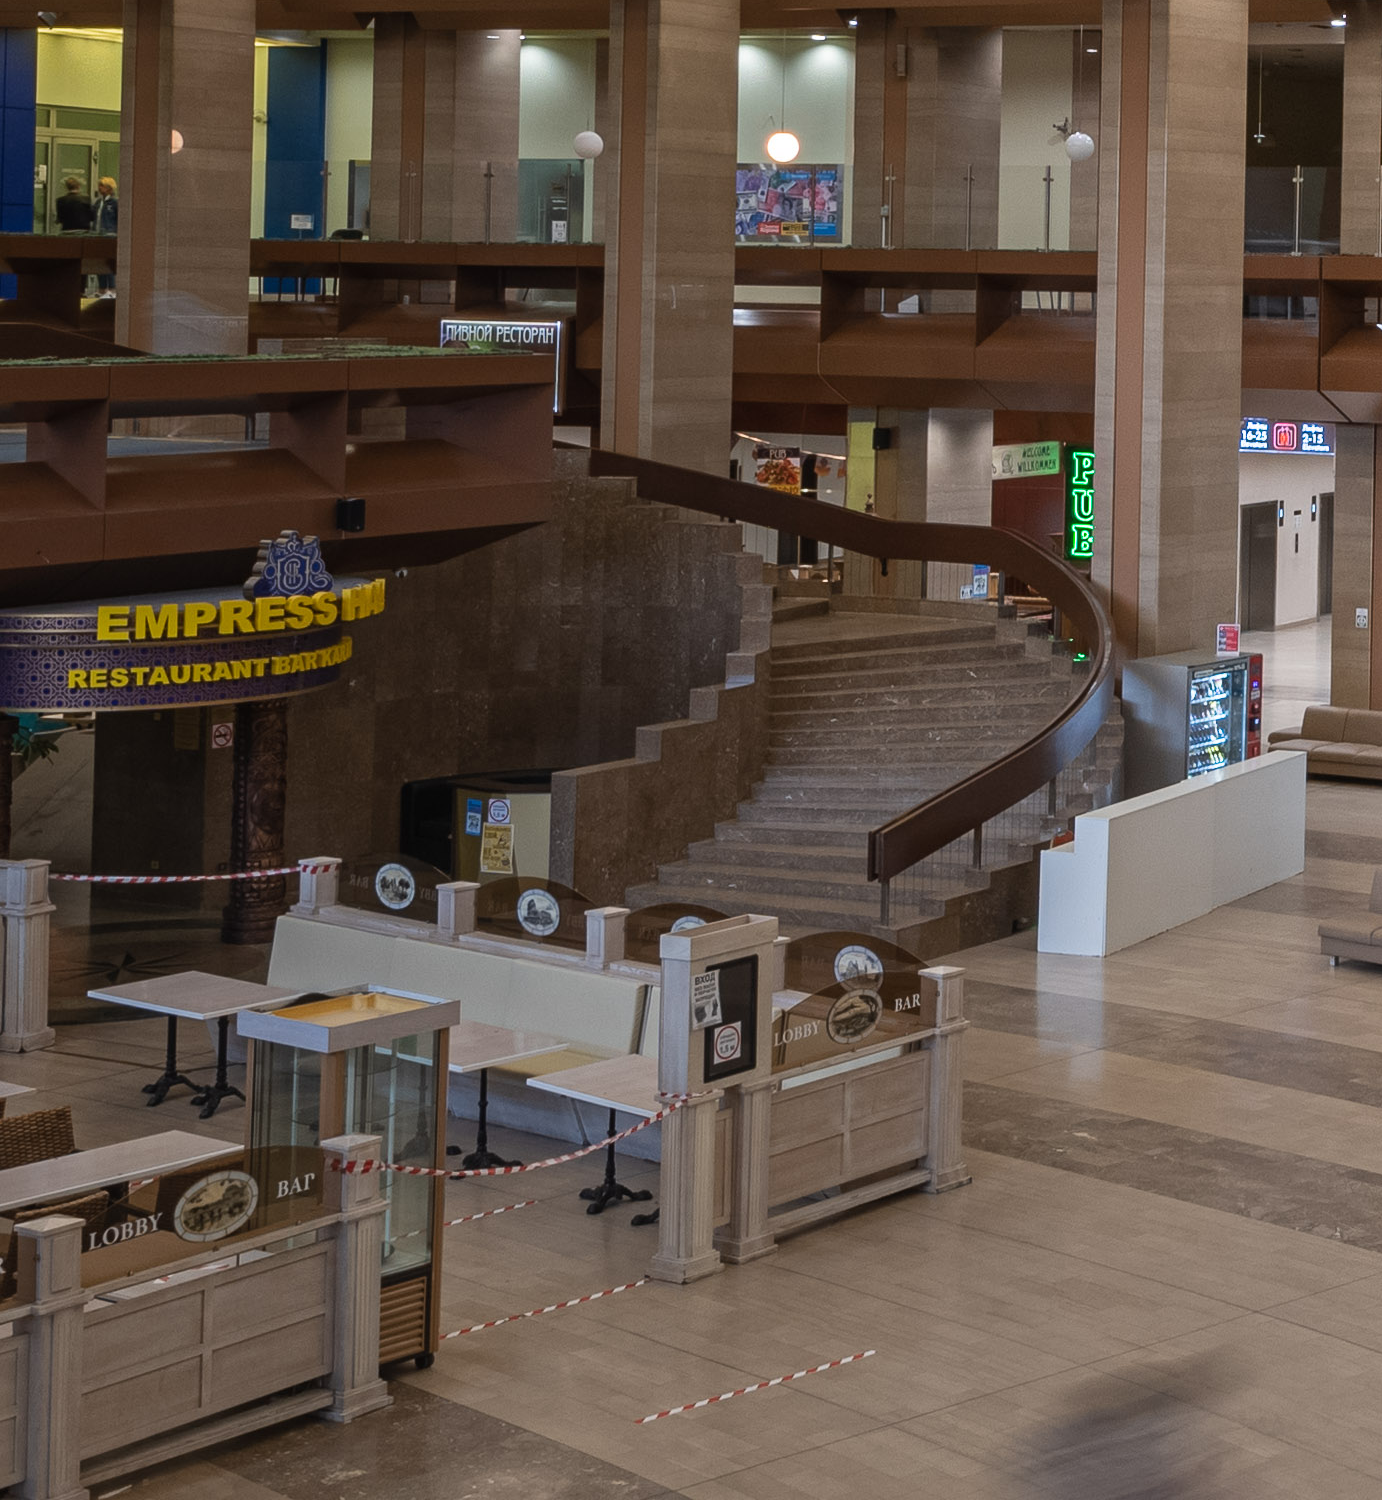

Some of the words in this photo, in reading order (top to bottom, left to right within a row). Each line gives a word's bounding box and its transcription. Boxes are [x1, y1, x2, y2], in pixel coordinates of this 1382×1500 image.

[446, 325, 492, 342] ПИВНОЙ
[496, 326, 554, 344] РЕСТОРАН
[1241, 430, 1268, 441] 16-25
[1302, 433, 1324, 444] 2-15
[769, 449, 787, 459] PUB
[1022, 445, 1051, 458] WELCOME
[1017, 459, 1057, 472] WILLKOMMEN
[1071, 452, 1095, 556] PUB
[97, 591, 338, 640] EMPRESS
[67, 657, 270, 688] RESTAURANT
[271, 651, 317, 675] BAR
[694, 972, 716, 986] ВХОД
[774, 1020, 821, 1047] LOBBY
[894, 993, 921, 1013] BAR
[88, 1212, 163, 1251] LOBBY
